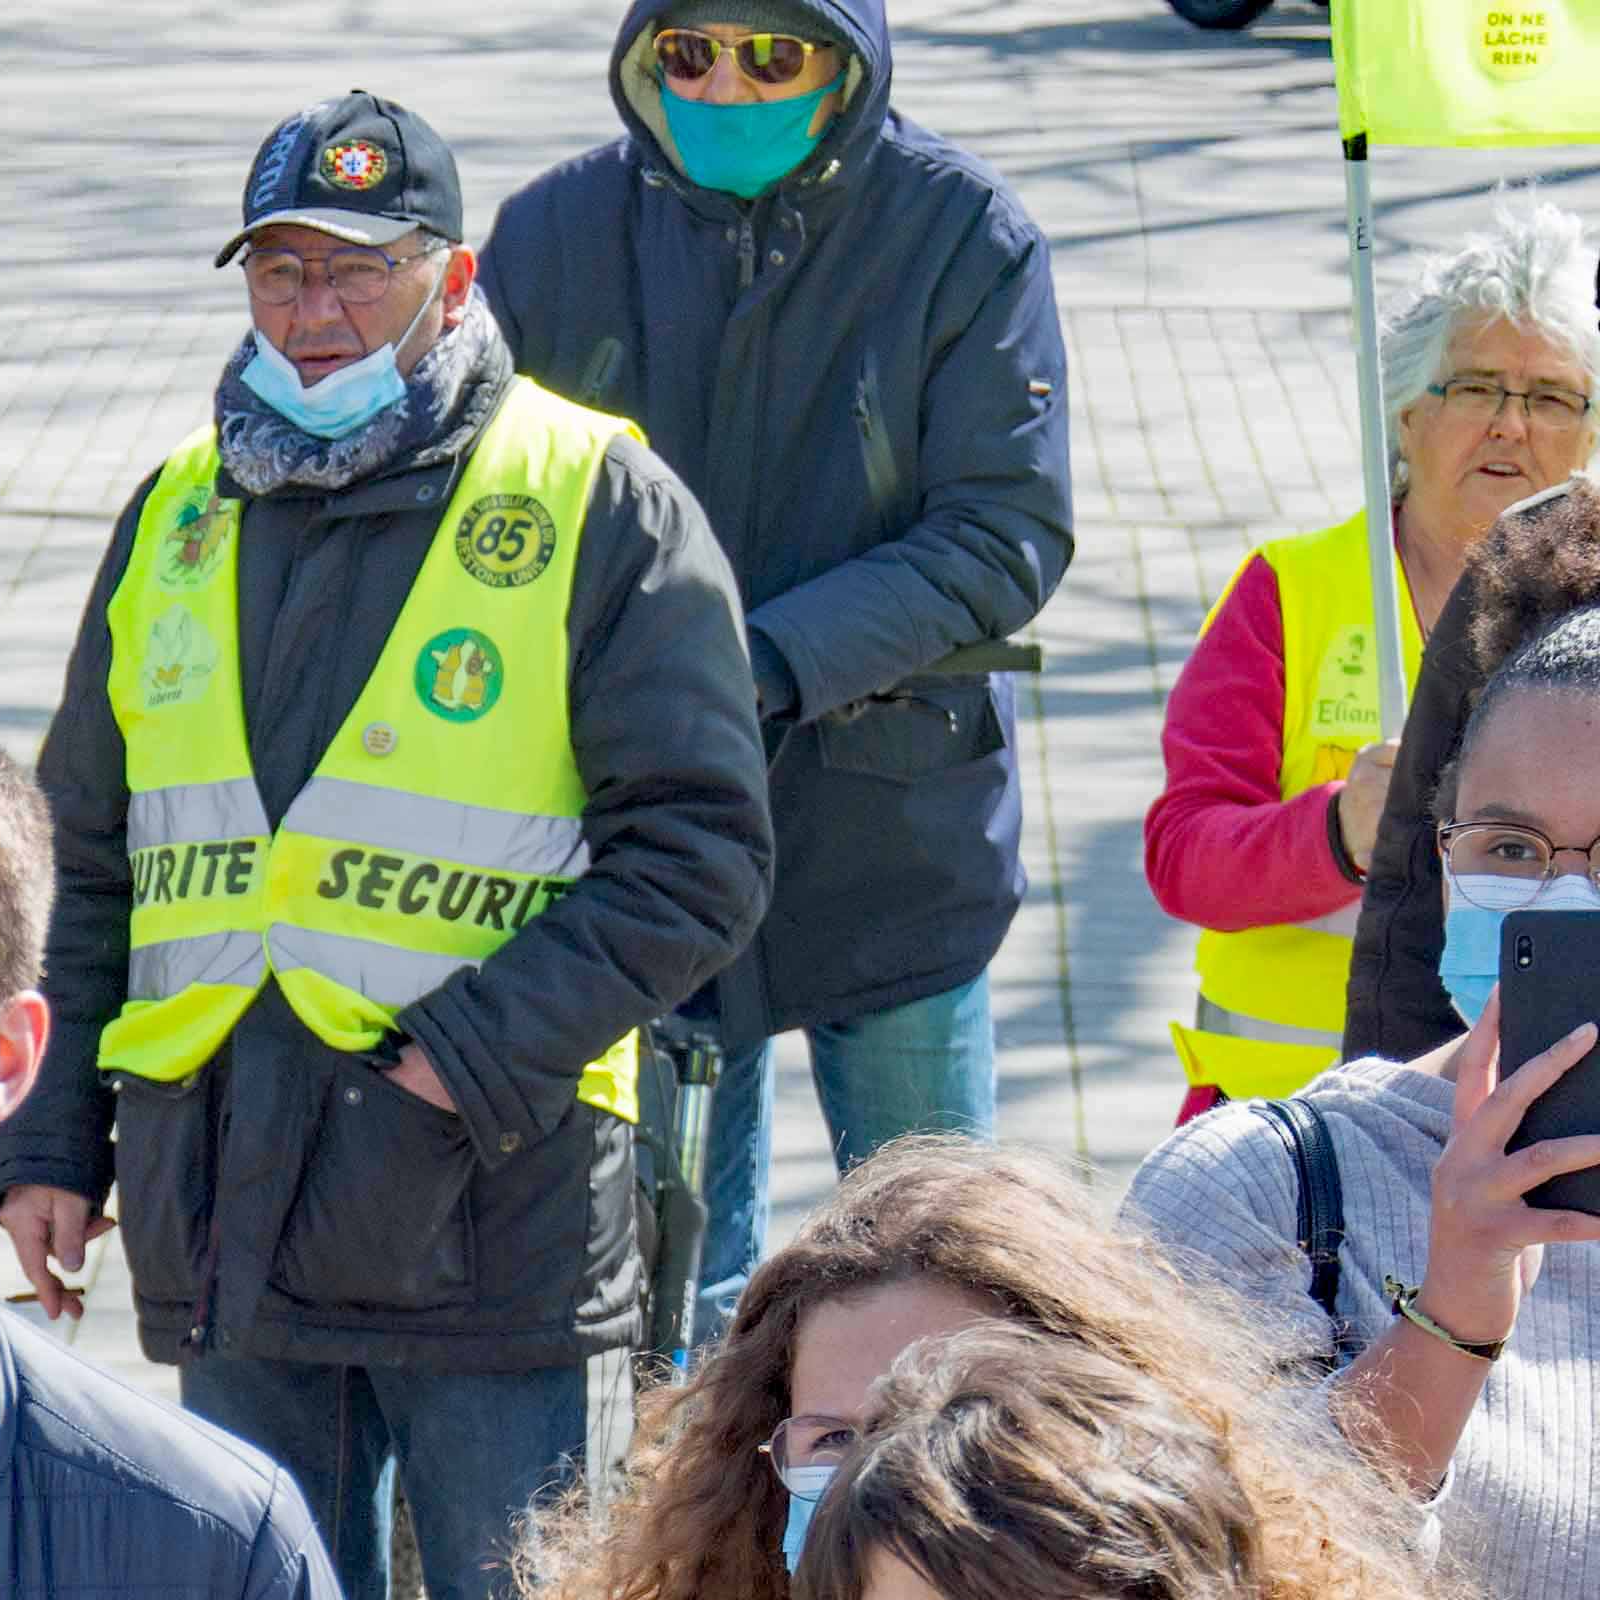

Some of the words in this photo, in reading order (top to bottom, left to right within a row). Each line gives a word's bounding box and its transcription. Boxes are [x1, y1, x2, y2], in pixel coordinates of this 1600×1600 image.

[1487, 13, 1513, 26] ON
[1521, 13, 1545, 25] NE
[1492, 51, 1537, 65] RIEN
[475, 515, 533, 562] 85
[131, 840, 257, 905] URITE
